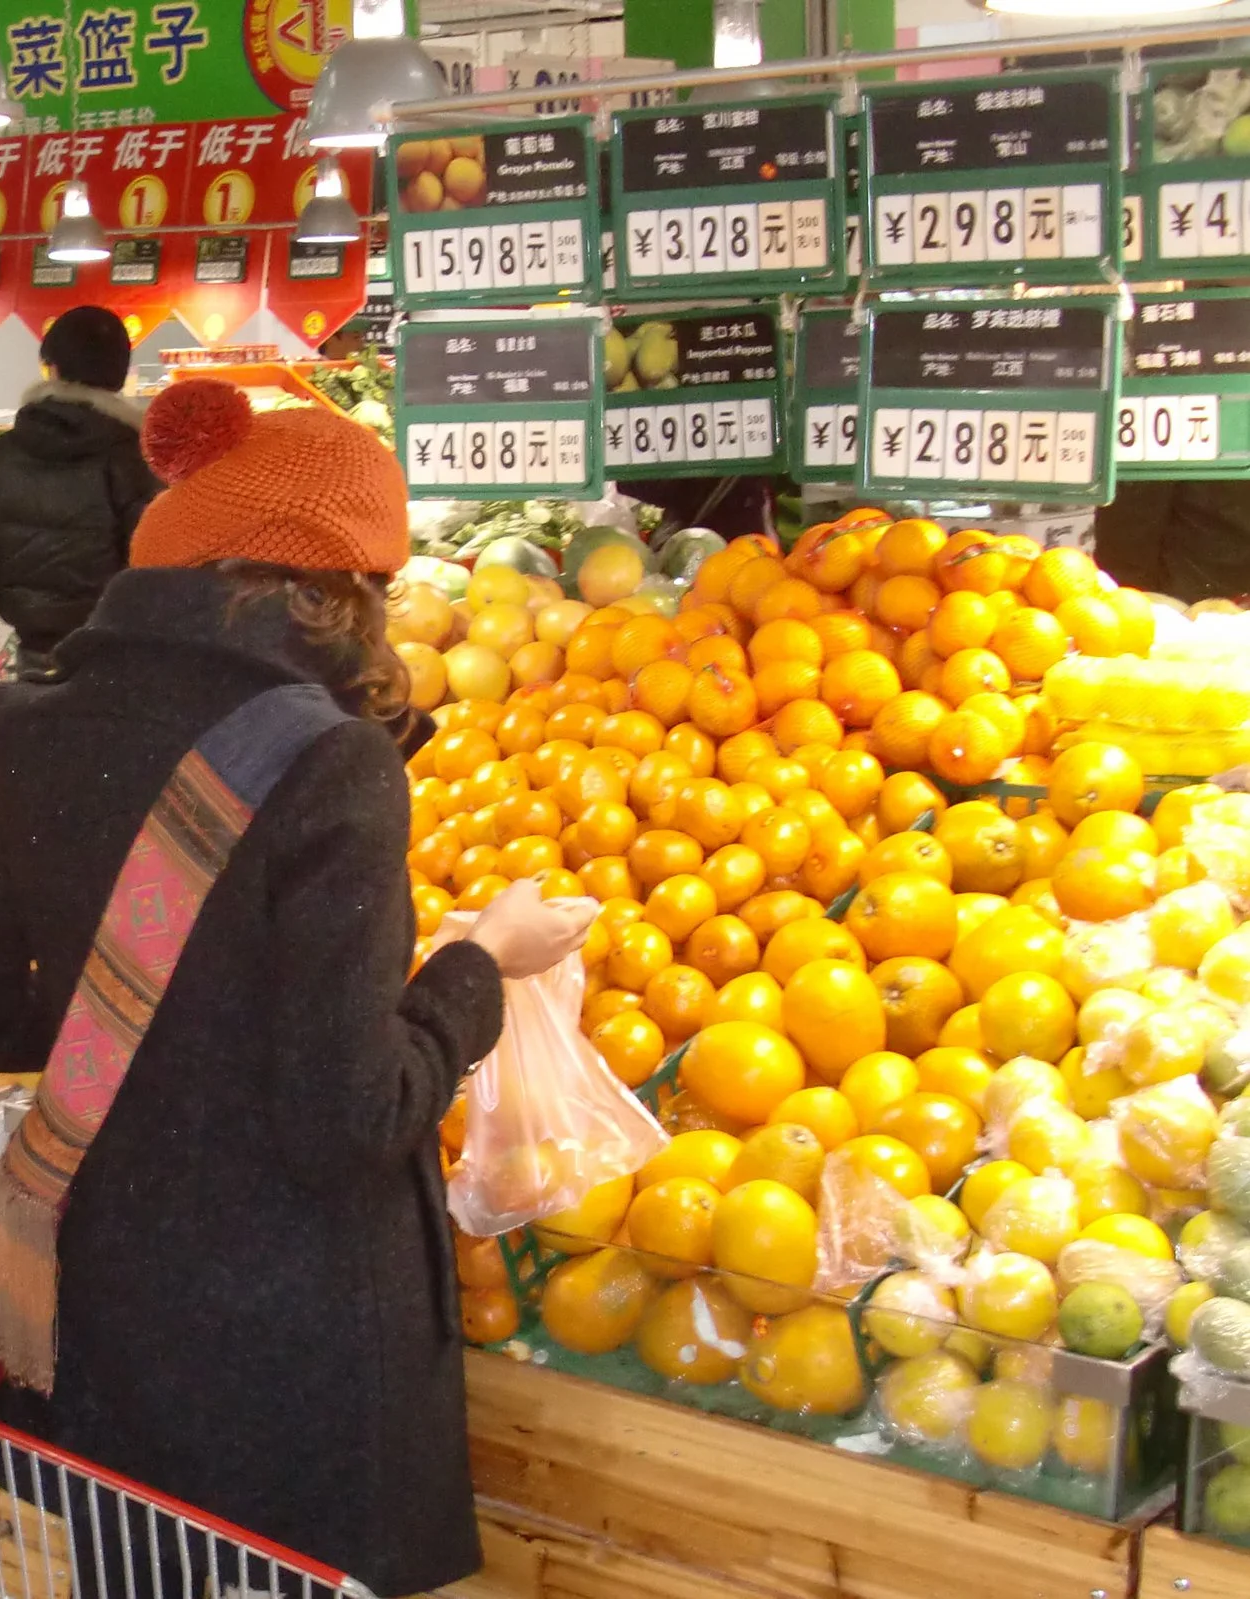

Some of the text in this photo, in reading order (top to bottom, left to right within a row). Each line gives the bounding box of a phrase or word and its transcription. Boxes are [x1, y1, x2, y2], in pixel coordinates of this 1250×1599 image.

[9, 5, 206, 97] 菜篮子
[34, 135, 104, 178] 低于
[111, 128, 188, 171] 低于
[197, 123, 276, 166] 低于
